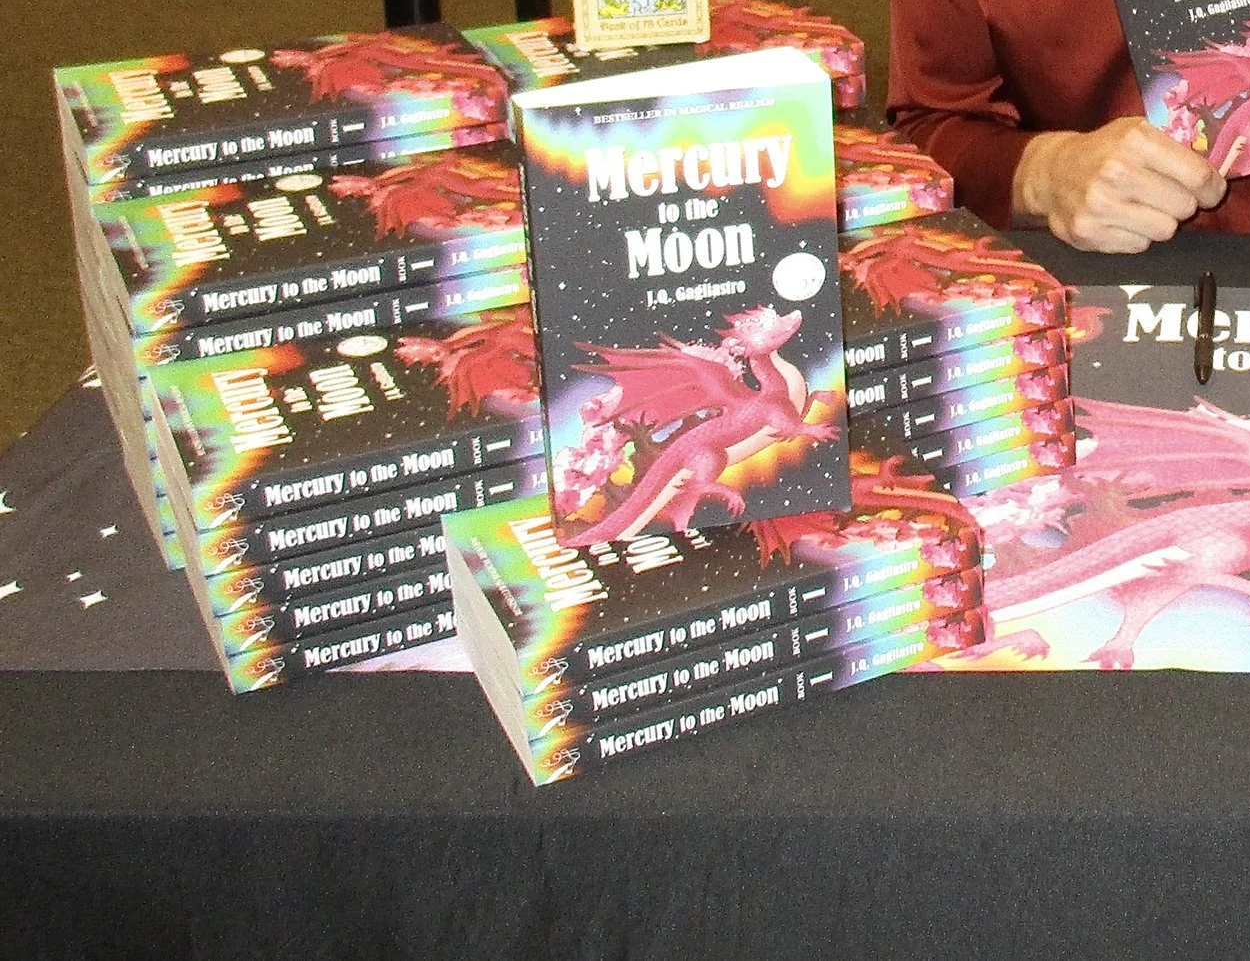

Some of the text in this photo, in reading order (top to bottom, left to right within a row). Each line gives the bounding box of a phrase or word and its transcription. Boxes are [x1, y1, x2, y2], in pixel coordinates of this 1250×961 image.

[594, 109, 663, 125] BESTSELLER
[664, 107, 678, 117] IN
[679, 103, 726, 116] MAGICAL
[148, 142, 218, 168] Mercury
[222, 140, 238, 155] to
[241, 136, 265, 153] the
[268, 126, 315, 149] Moon
[584, 134, 793, 203] Mercury
[657, 198, 719, 224] to the
[624, 222, 755, 279] Moon
[202, 265, 382, 314] Mercury to the Moon
[647, 280, 746, 308] J.Q. Gagliastro
[197, 308, 377, 358] Mercury to the Moon
[264, 472, 345, 508] Mercury
[349, 469, 368, 489] to
[370, 463, 398, 483] the
[402, 448, 455, 476] Moon
[268, 491, 457, 553] Mercury to the Moon
[283, 544, 415, 590] Mercury to the
[587, 630, 665, 670] Mercury
[669, 627, 687, 645] to
[690, 618, 716, 639] the
[721, 599, 771, 630] Moon
[592, 671, 668, 712] Mercury
[672, 668, 690, 687] to
[693, 659, 719, 681] the
[724, 640, 775, 671] Moon
[599, 718, 675, 759] Mercury
[679, 714, 697, 733] to
[699, 705, 725, 727] the
[729, 685, 779, 716] Moon
